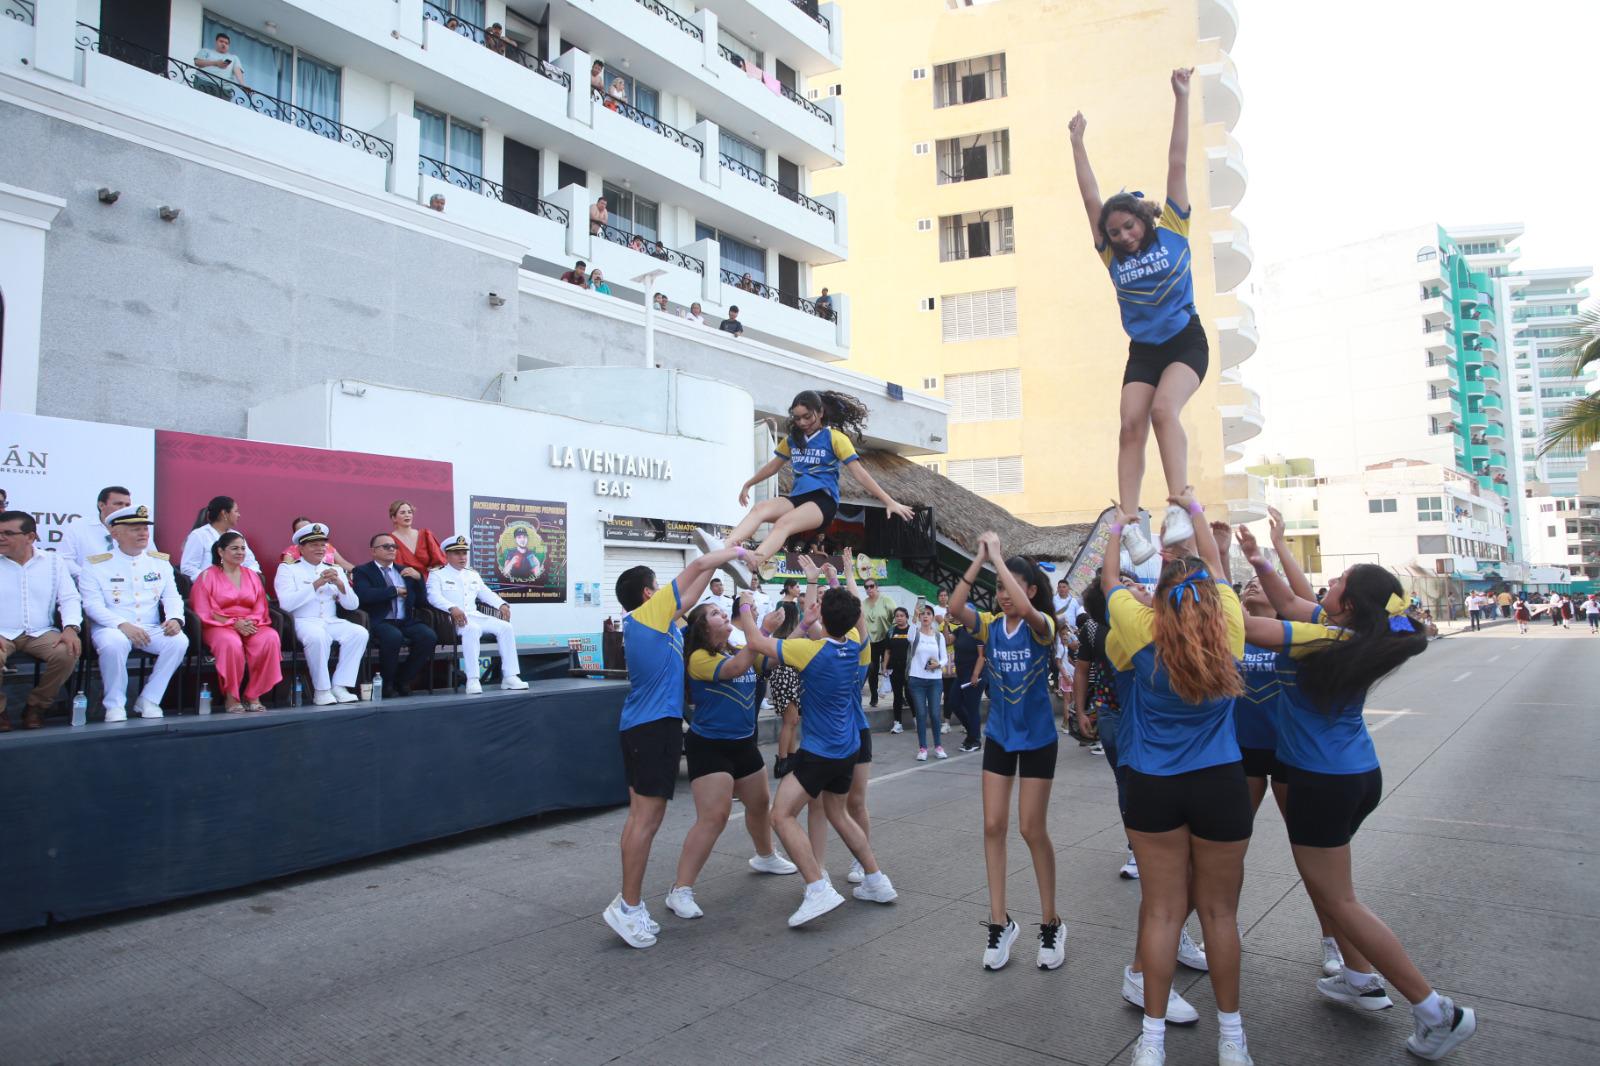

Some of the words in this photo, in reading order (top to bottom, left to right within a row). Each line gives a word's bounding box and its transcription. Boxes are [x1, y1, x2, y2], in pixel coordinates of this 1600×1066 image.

[1120, 258, 1170, 285] HISPANO
[549, 444, 575, 469] LA
[578, 447, 674, 481] VENTANITA
[594, 479, 633, 499] BAR
